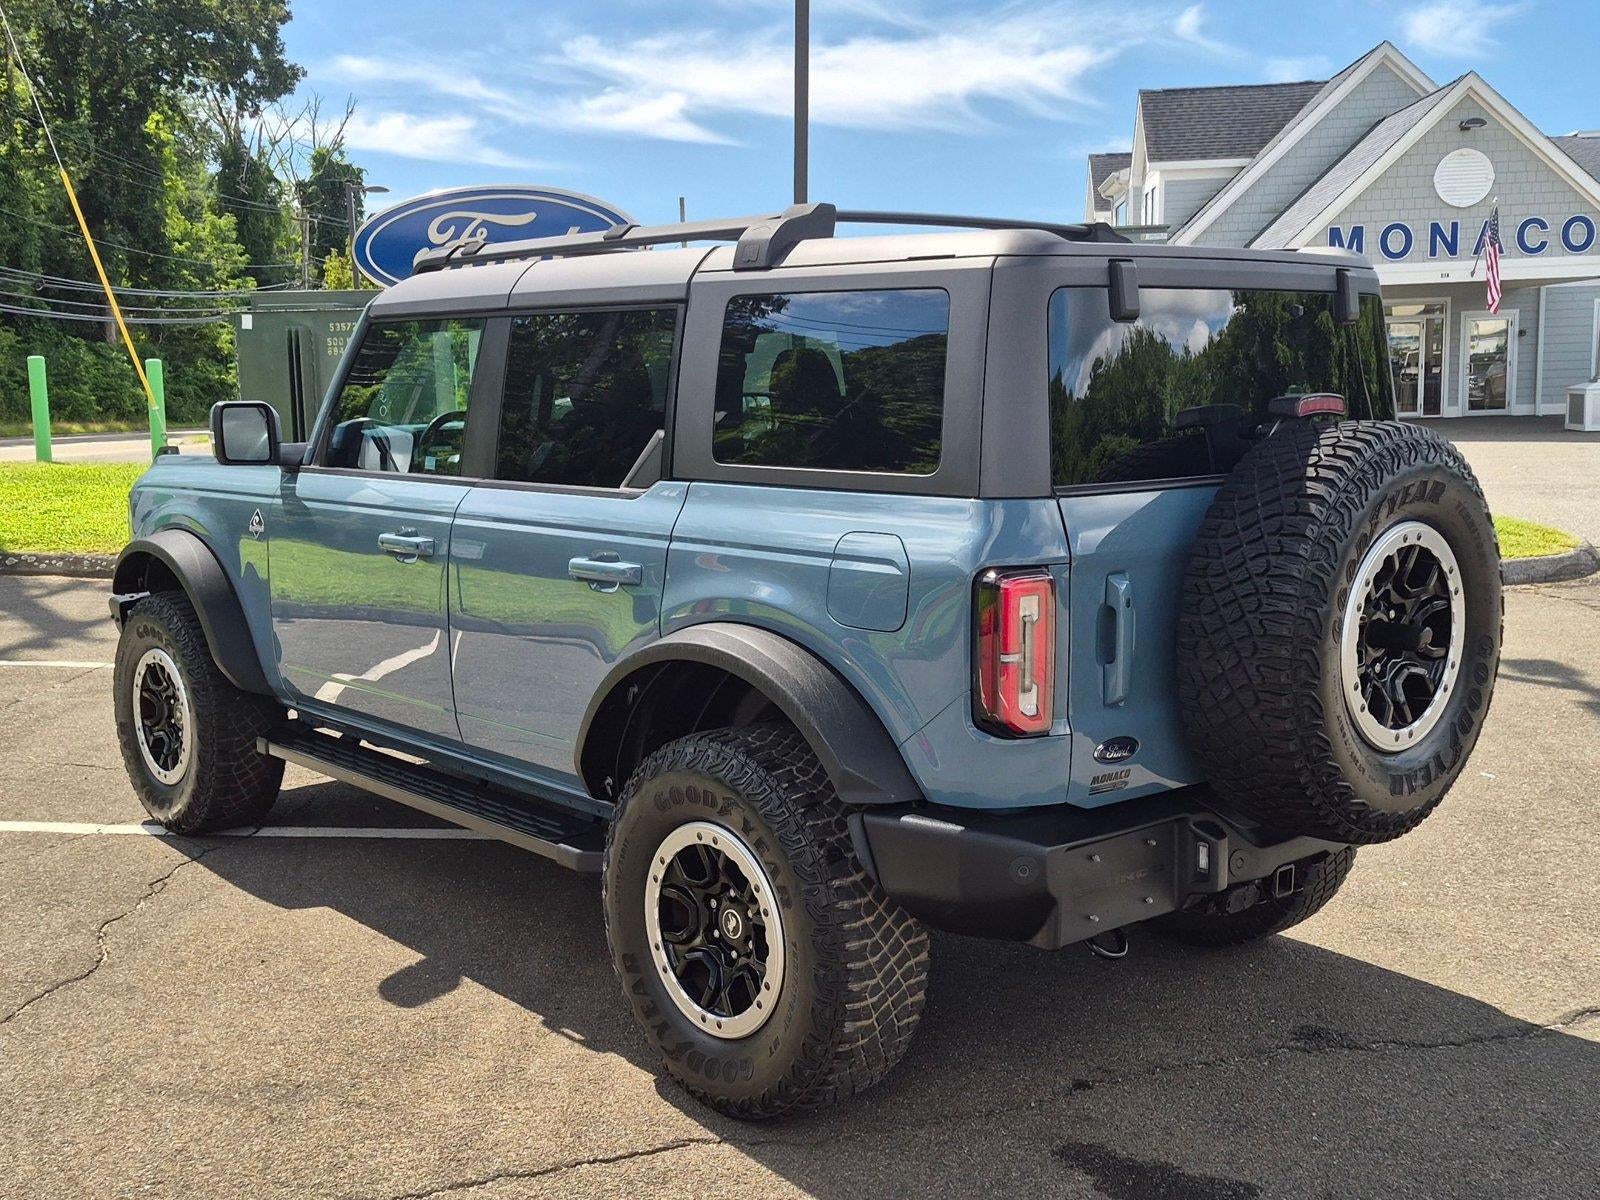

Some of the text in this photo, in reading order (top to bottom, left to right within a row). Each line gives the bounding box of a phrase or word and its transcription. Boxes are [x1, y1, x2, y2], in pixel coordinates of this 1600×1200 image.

[1390, 634, 1495, 797] GOODYEAR
[1090, 768, 1132, 786] MONACO
[1105, 743, 1132, 760] Ford
[655, 785, 792, 910] GOODYEAR
